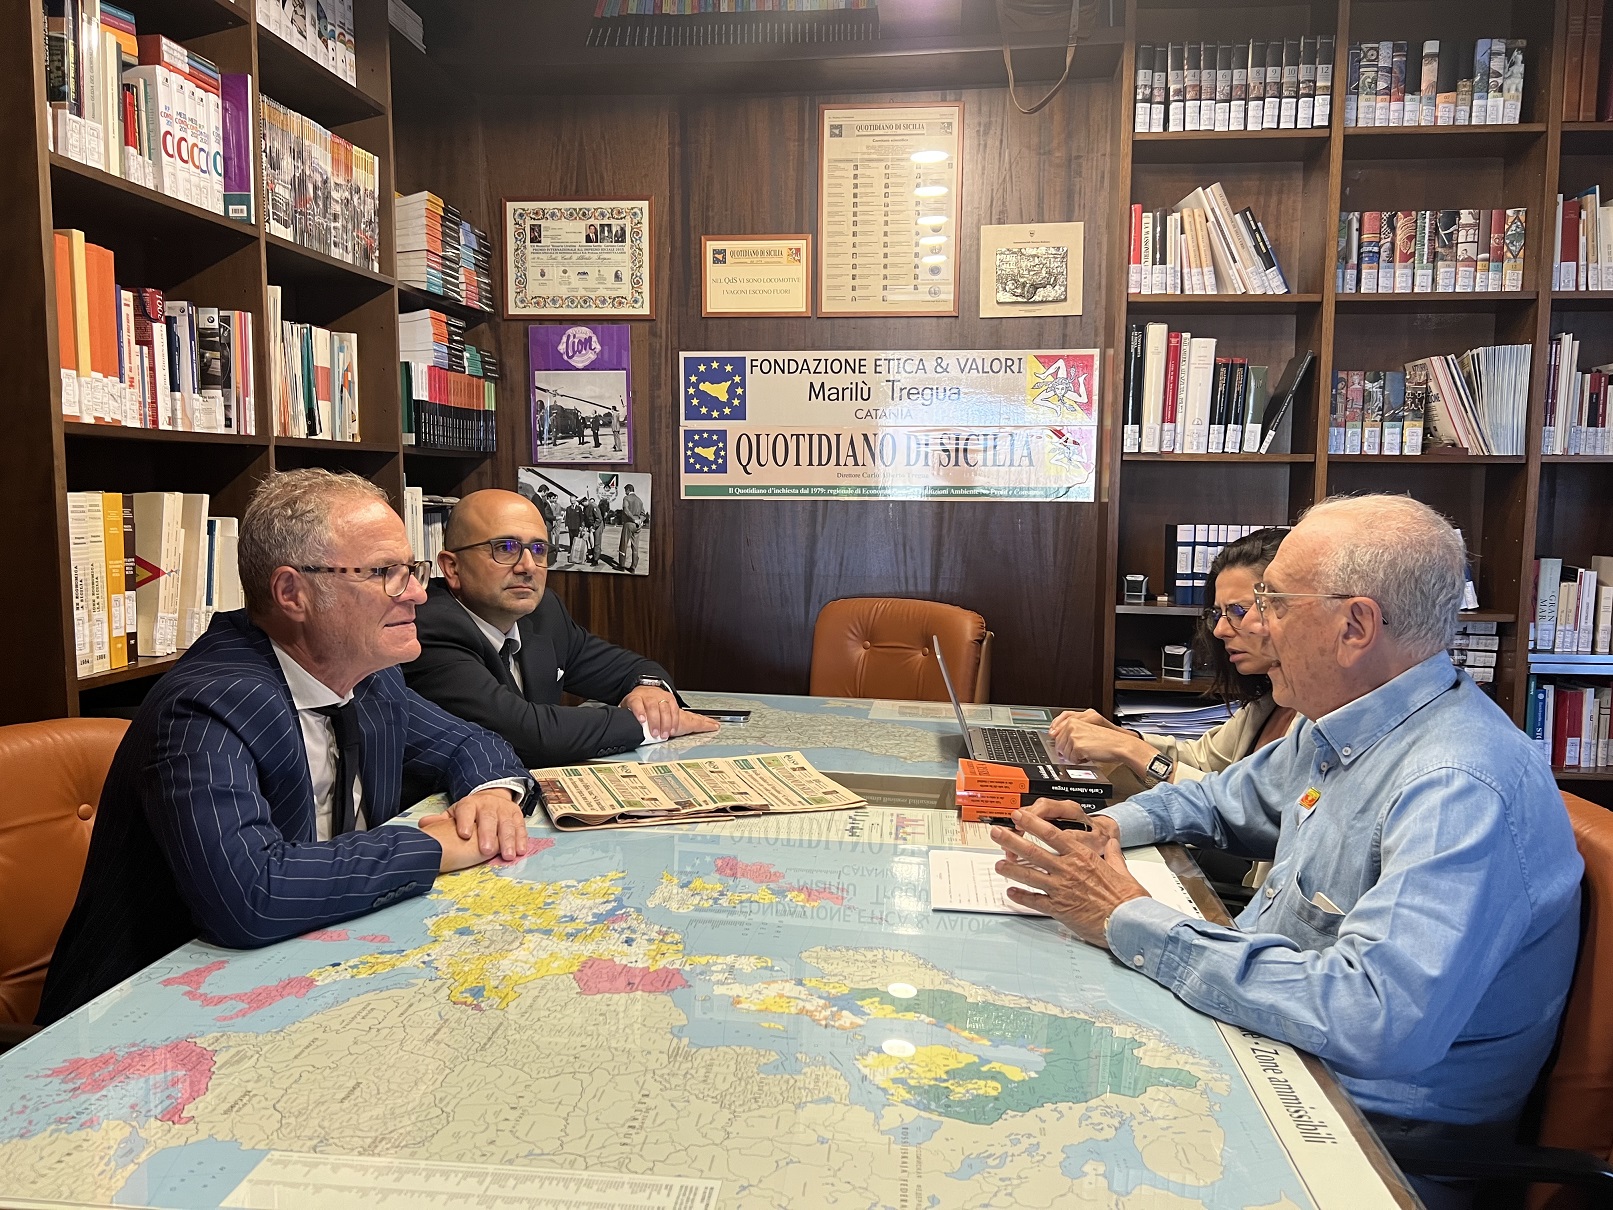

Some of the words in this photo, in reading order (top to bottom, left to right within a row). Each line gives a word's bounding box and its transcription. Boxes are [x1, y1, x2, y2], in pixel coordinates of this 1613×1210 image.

[730, 249, 759, 258] QUOTIDIANO
[750, 359, 866, 374] FONDAZIONE
[874, 358, 927, 374] ETICA
[934, 357, 950, 374] &
[956, 358, 1023, 374] VALORI
[808, 380, 871, 401] Marilù
[886, 379, 961, 406] Tregua
[854, 409, 913, 420] CATANIA
[735, 433, 896, 475] QUOTIDIANO
[905, 432, 930, 467] DI
[939, 432, 1035, 468] SICILIA
[1539, 599, 1547, 620] MAR
[1548, 595, 1556, 622] GRAN
[1250, 1047, 1283, 1074] Zone
[1267, 1076, 1338, 1144] ammissibili
